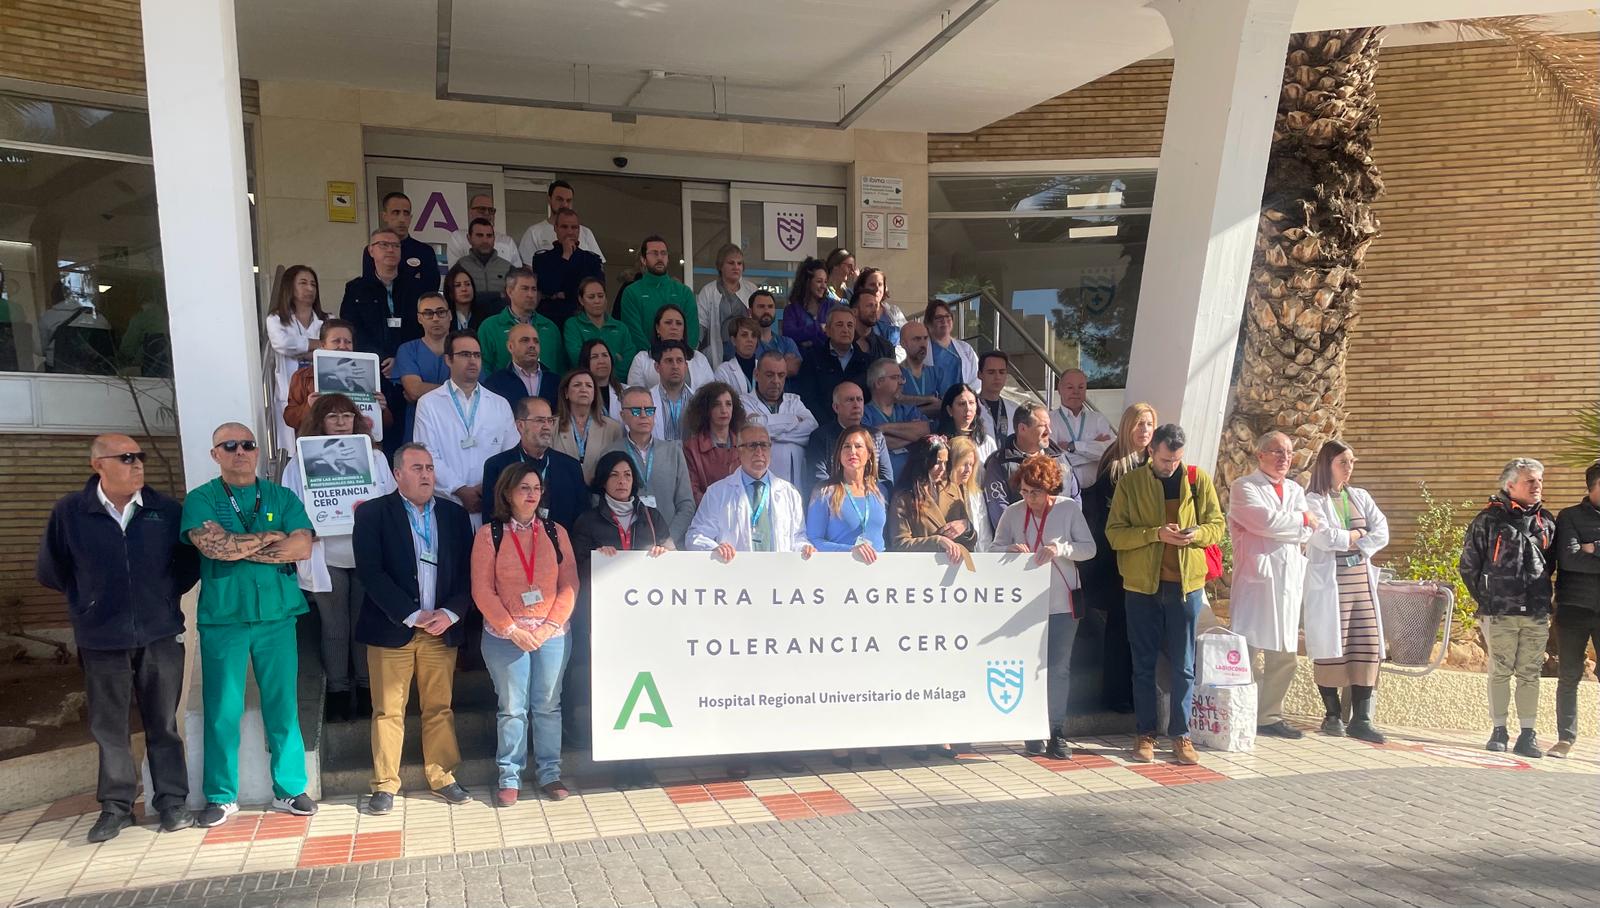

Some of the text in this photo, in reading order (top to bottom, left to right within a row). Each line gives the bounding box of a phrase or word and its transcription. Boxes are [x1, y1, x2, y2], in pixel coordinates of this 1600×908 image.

[312, 487, 369, 499] TOLERANCIA
[313, 497, 339, 507] CERO
[624, 586, 1024, 606] CONTRA LAS AGRESIONES
[686, 634, 970, 656] TOLERANCIA CERO
[698, 686, 966, 709] Hospital Regional Universitario de Málaga
